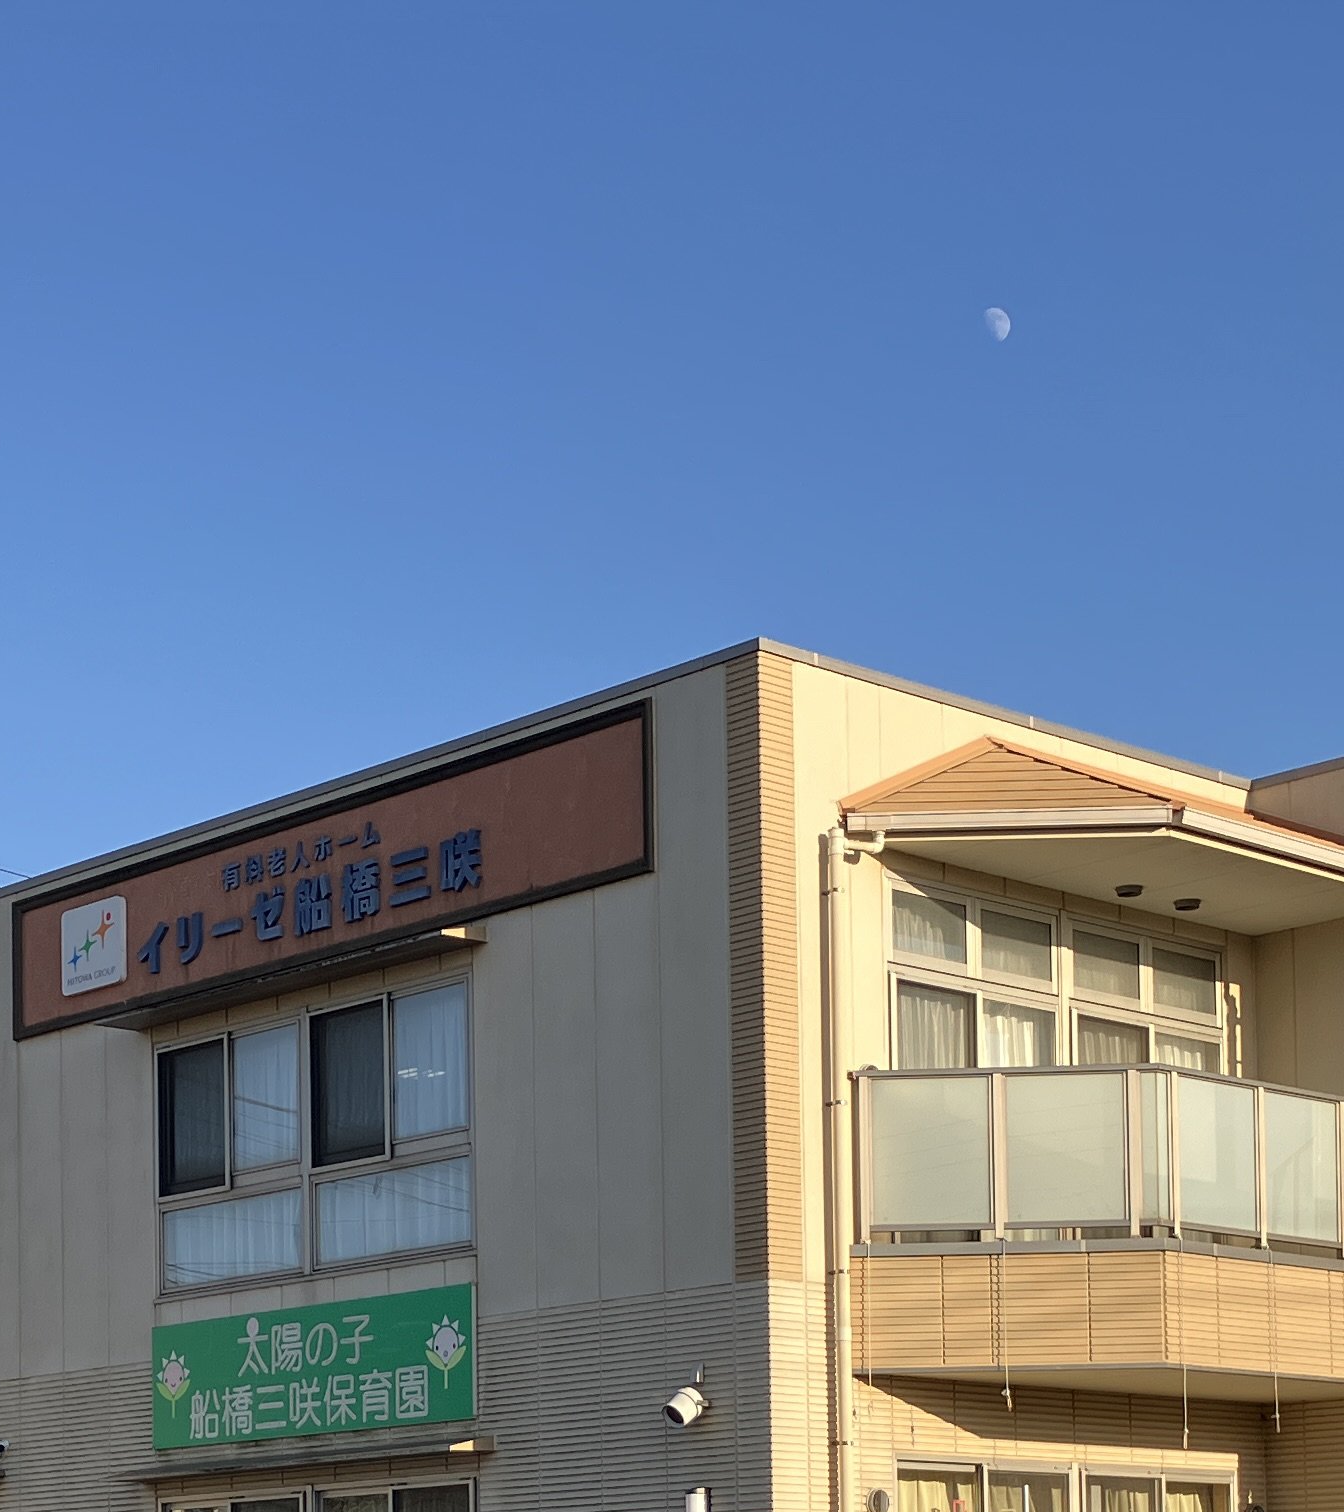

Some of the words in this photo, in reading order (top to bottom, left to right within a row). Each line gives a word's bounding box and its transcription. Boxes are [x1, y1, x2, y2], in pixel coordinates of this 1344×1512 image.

[221, 822, 381, 892] 有料老人ホーム
[137, 828, 482, 974] イリーゼ船橋三咲
[94, 966, 116, 979] GROUP
[237, 1314, 374, 1377] 太陽の子
[189, 1364, 429, 1440] 船橋三咲保育園
